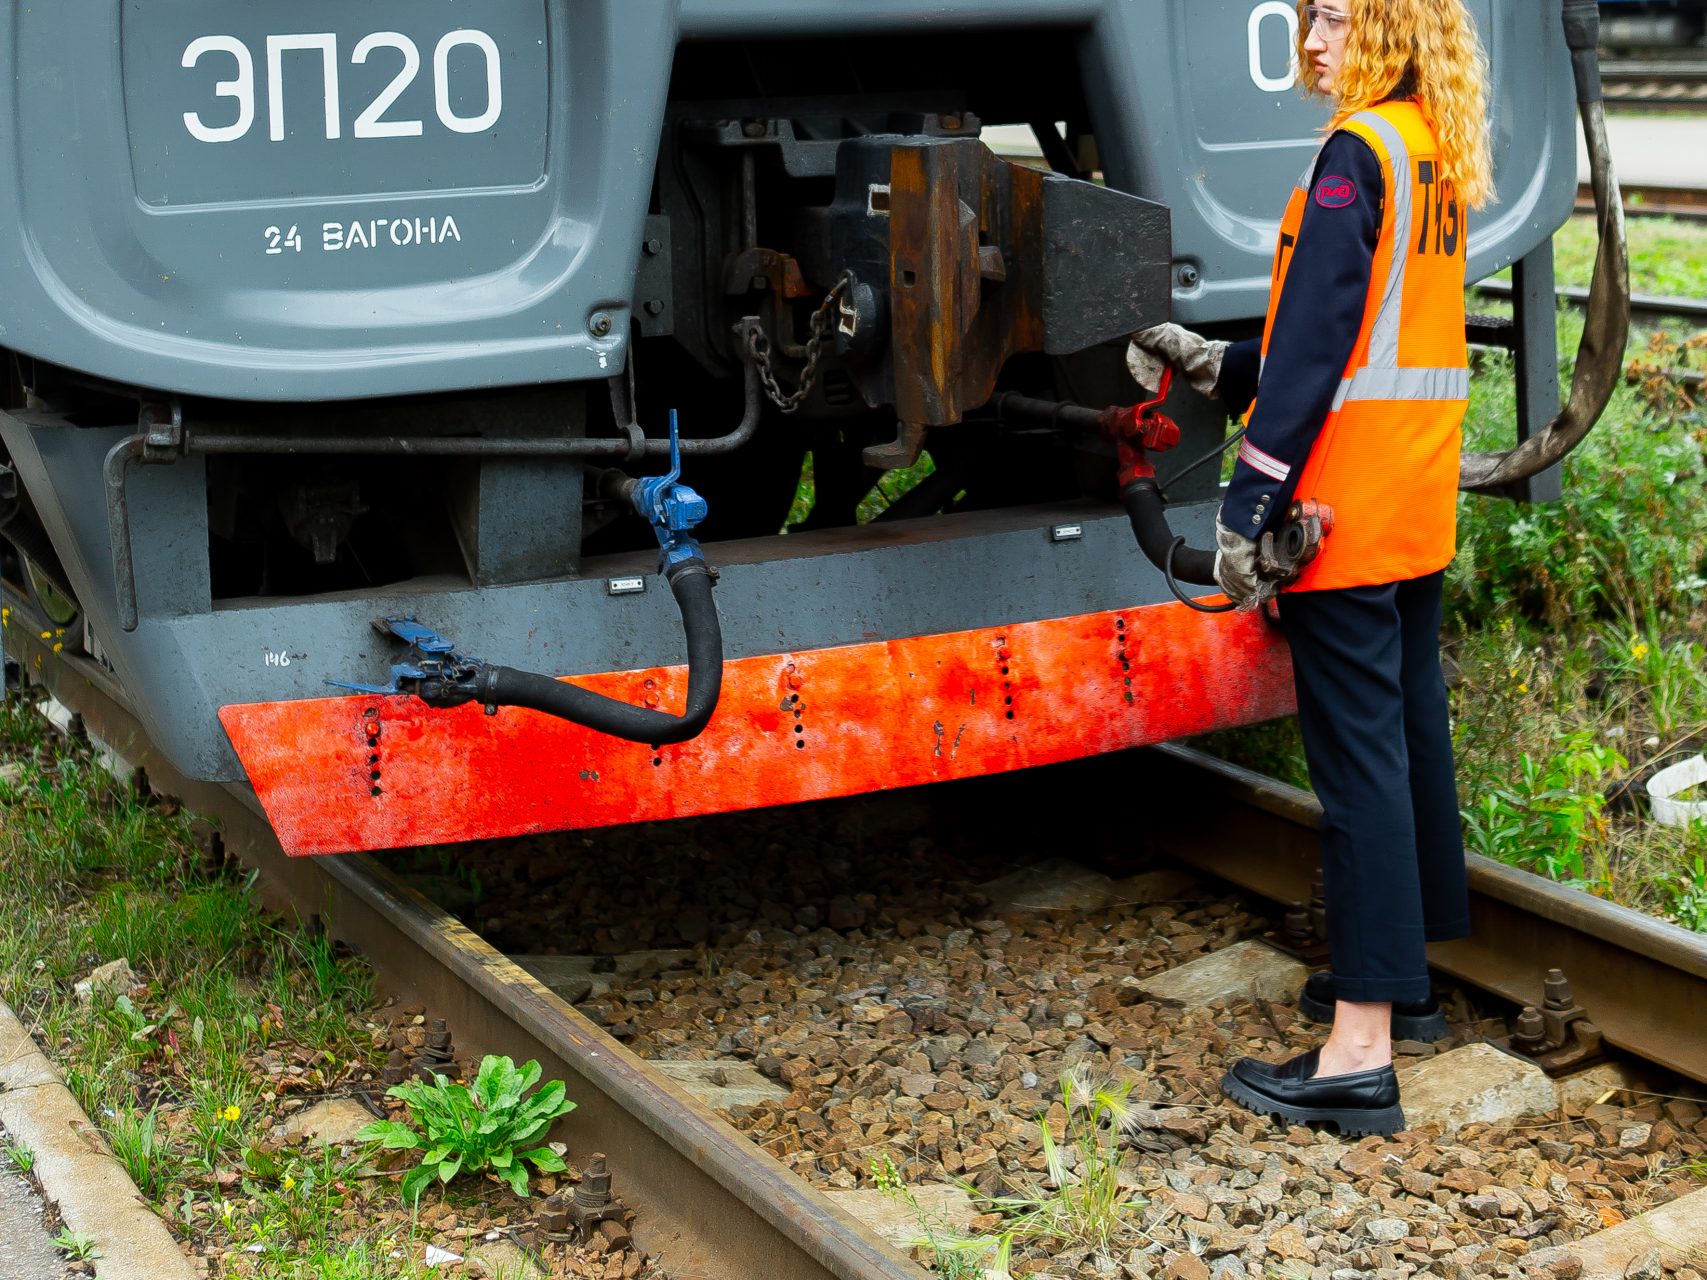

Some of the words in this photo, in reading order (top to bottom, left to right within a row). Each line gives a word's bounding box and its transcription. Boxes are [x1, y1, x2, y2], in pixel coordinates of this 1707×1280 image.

[181, 29, 502, 143] ЭП20
[264, 223, 302, 255] 24
[322, 215, 462, 251] ВАГОНА
[264, 650, 291, 667] 146
